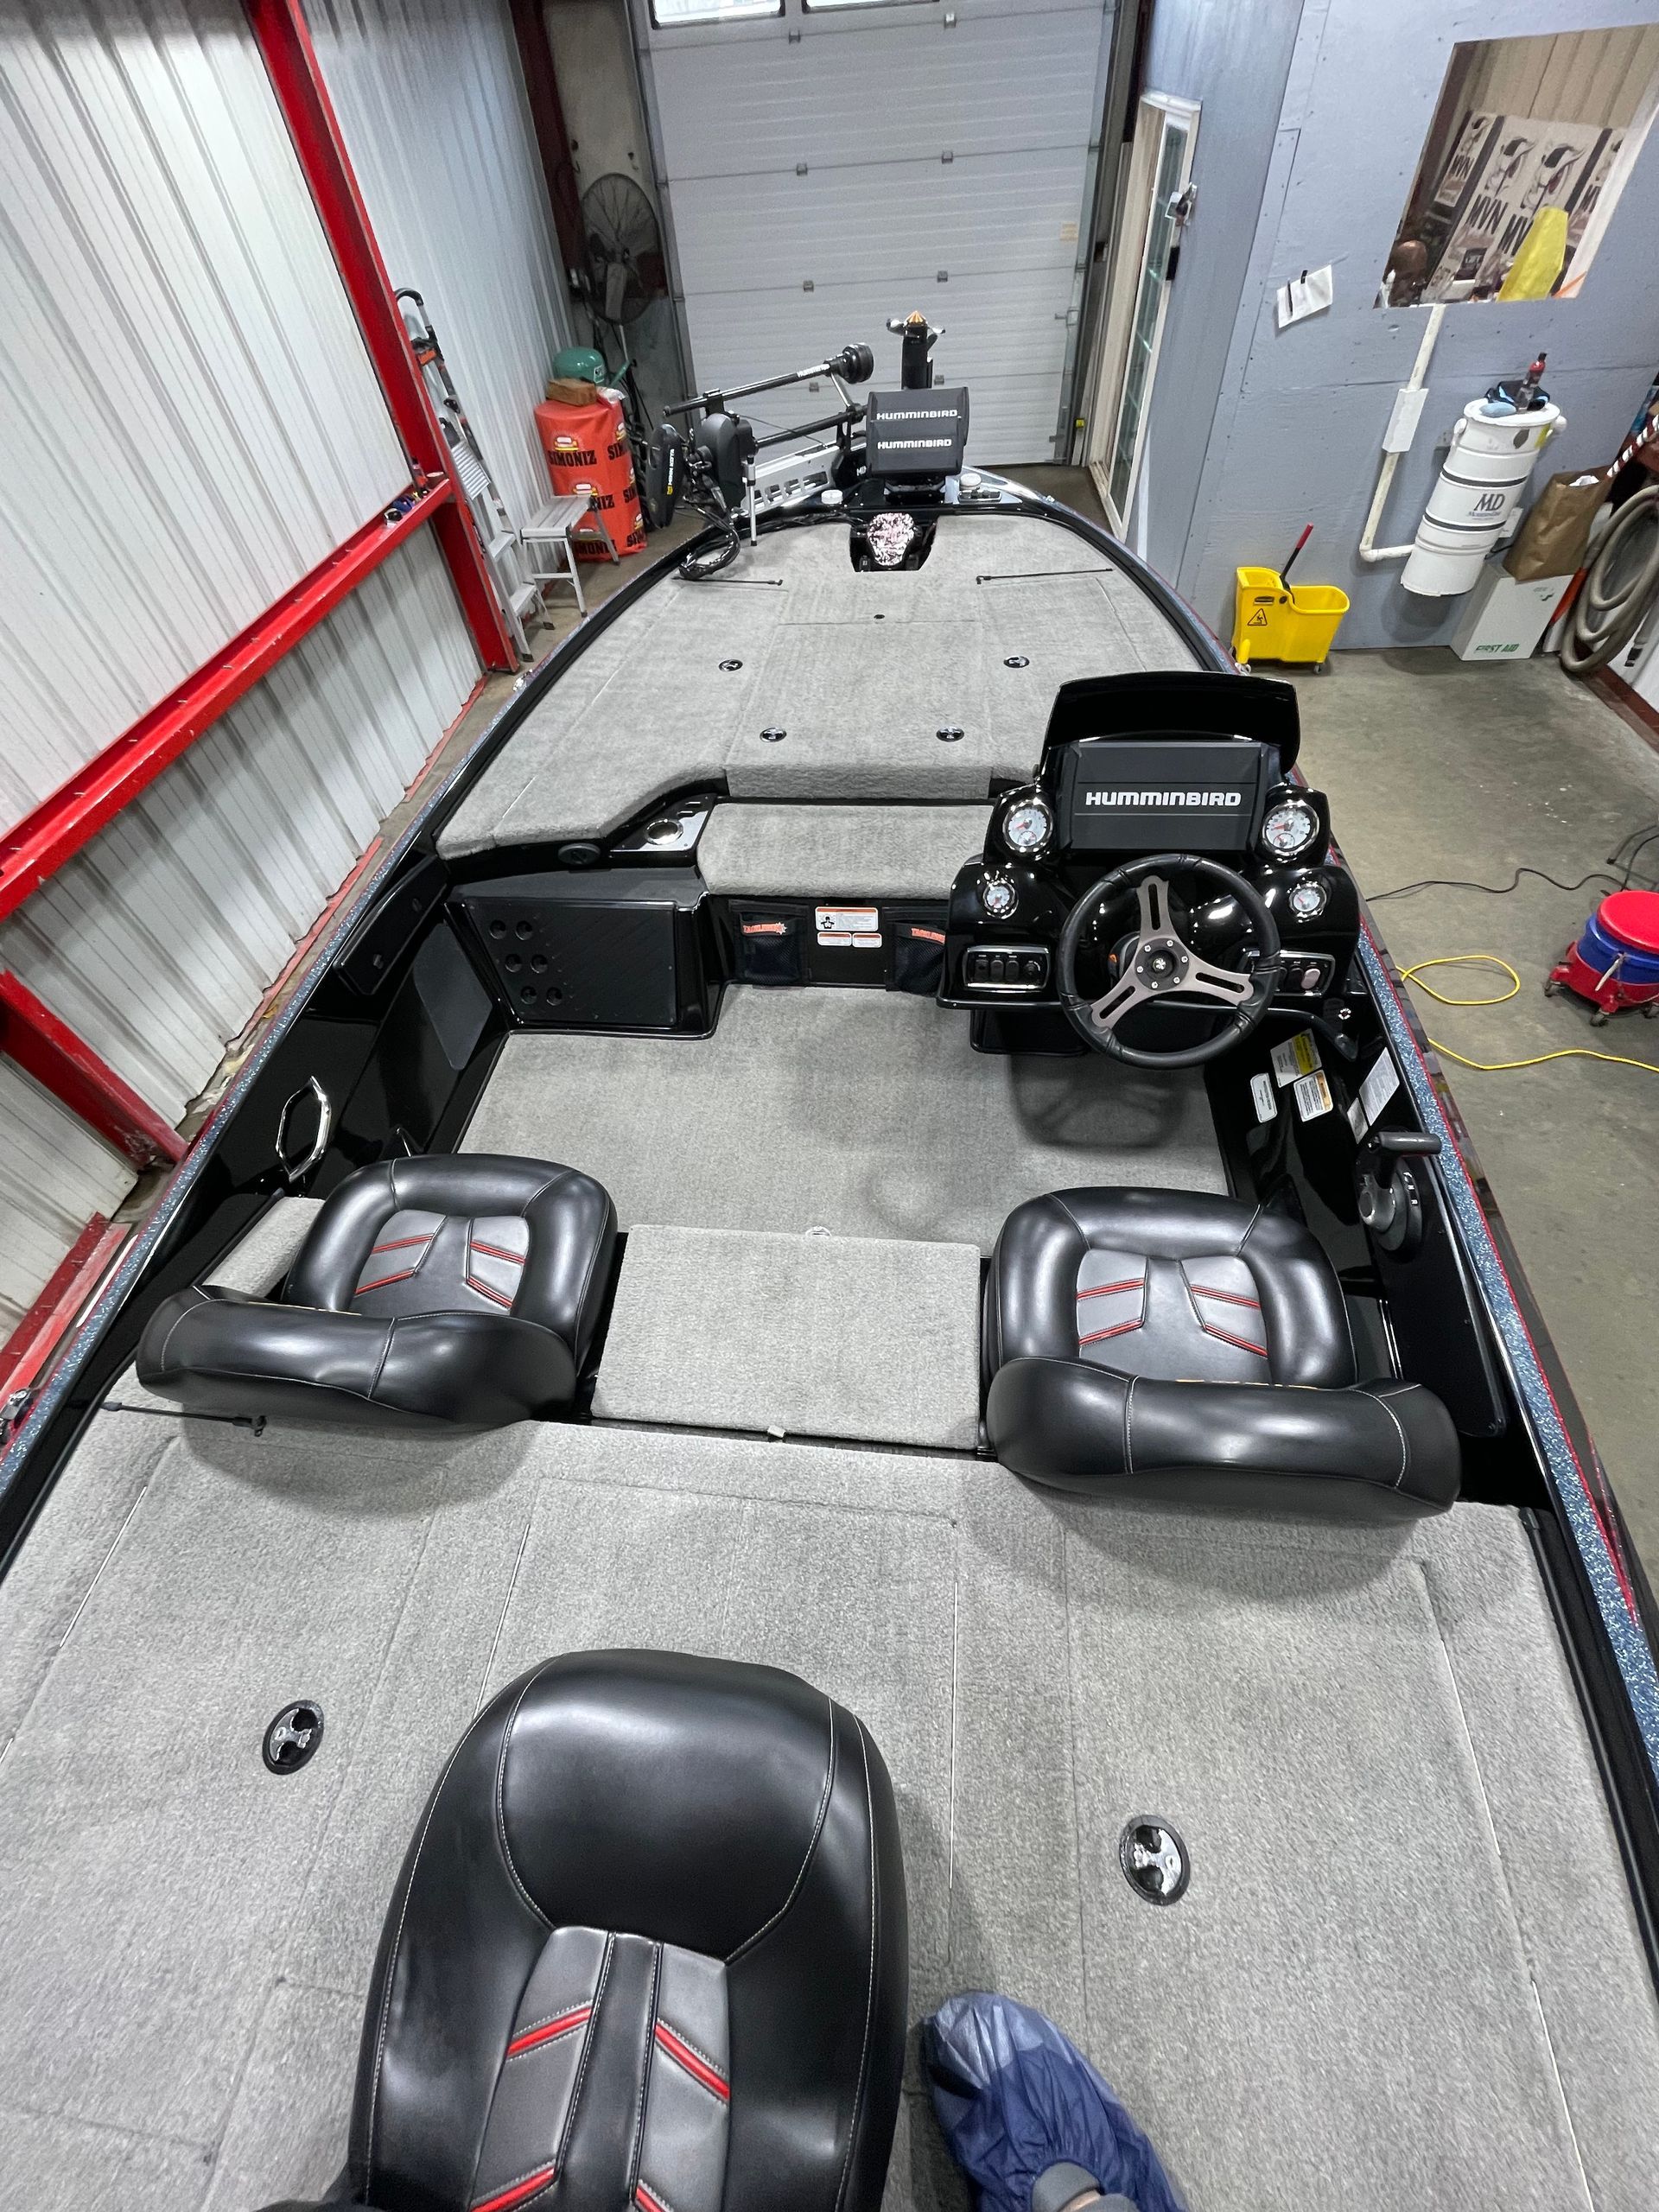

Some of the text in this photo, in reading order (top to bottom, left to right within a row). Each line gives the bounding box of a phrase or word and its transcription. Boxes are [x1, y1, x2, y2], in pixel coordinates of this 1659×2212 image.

[876, 409, 958, 421] HUMMINBIRD
[877, 438, 952, 450] HUMMINBIRD
[548, 449, 597, 467] SIMONIZ
[1473, 493, 1506, 512] MD
[1473, 643, 1521, 653] FIRST AID
[1085, 791, 1242, 807] HUMMINBIRD
